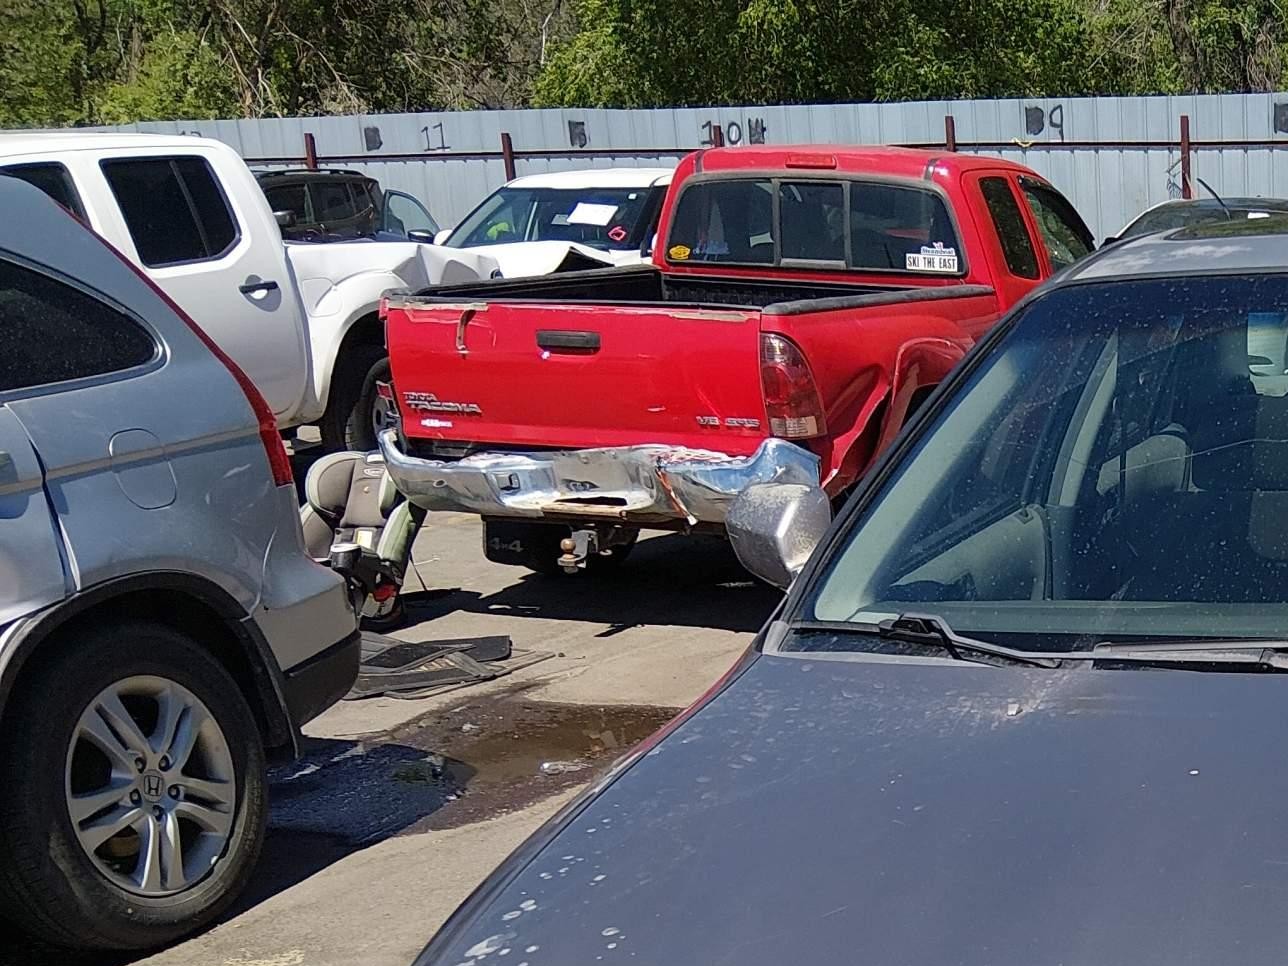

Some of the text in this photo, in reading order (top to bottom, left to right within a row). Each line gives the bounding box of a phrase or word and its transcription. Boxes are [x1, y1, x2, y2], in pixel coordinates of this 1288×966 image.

[420, 121, 451, 151] 11
[923, 256, 936, 269] THE
[939, 257, 956, 270] EAST
